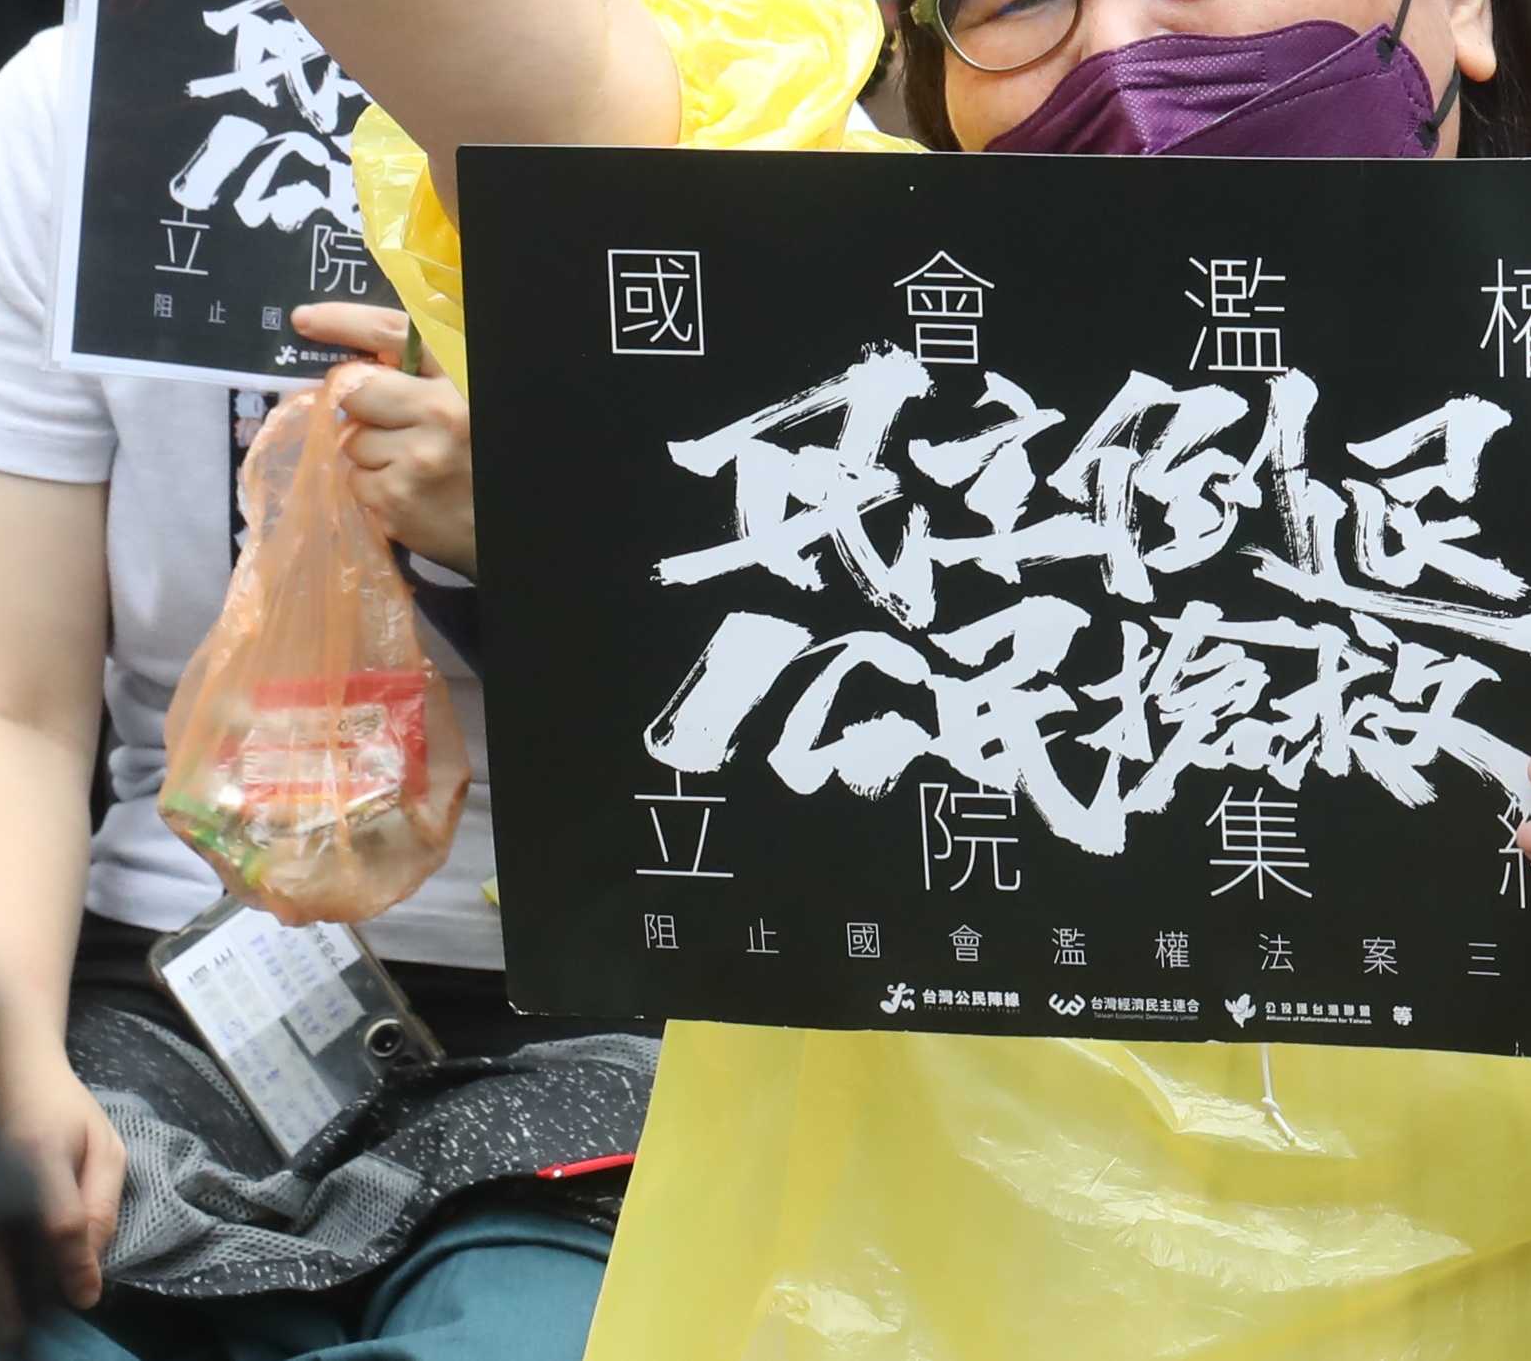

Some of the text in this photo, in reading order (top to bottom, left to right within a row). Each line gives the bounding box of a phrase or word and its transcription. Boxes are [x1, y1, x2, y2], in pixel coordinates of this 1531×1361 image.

[154, 207, 369, 295] 立院
[922, 988, 1414, 1027] 台灣公民陣線 台灣經濟民主連合 公投護台灣聯盟 等
